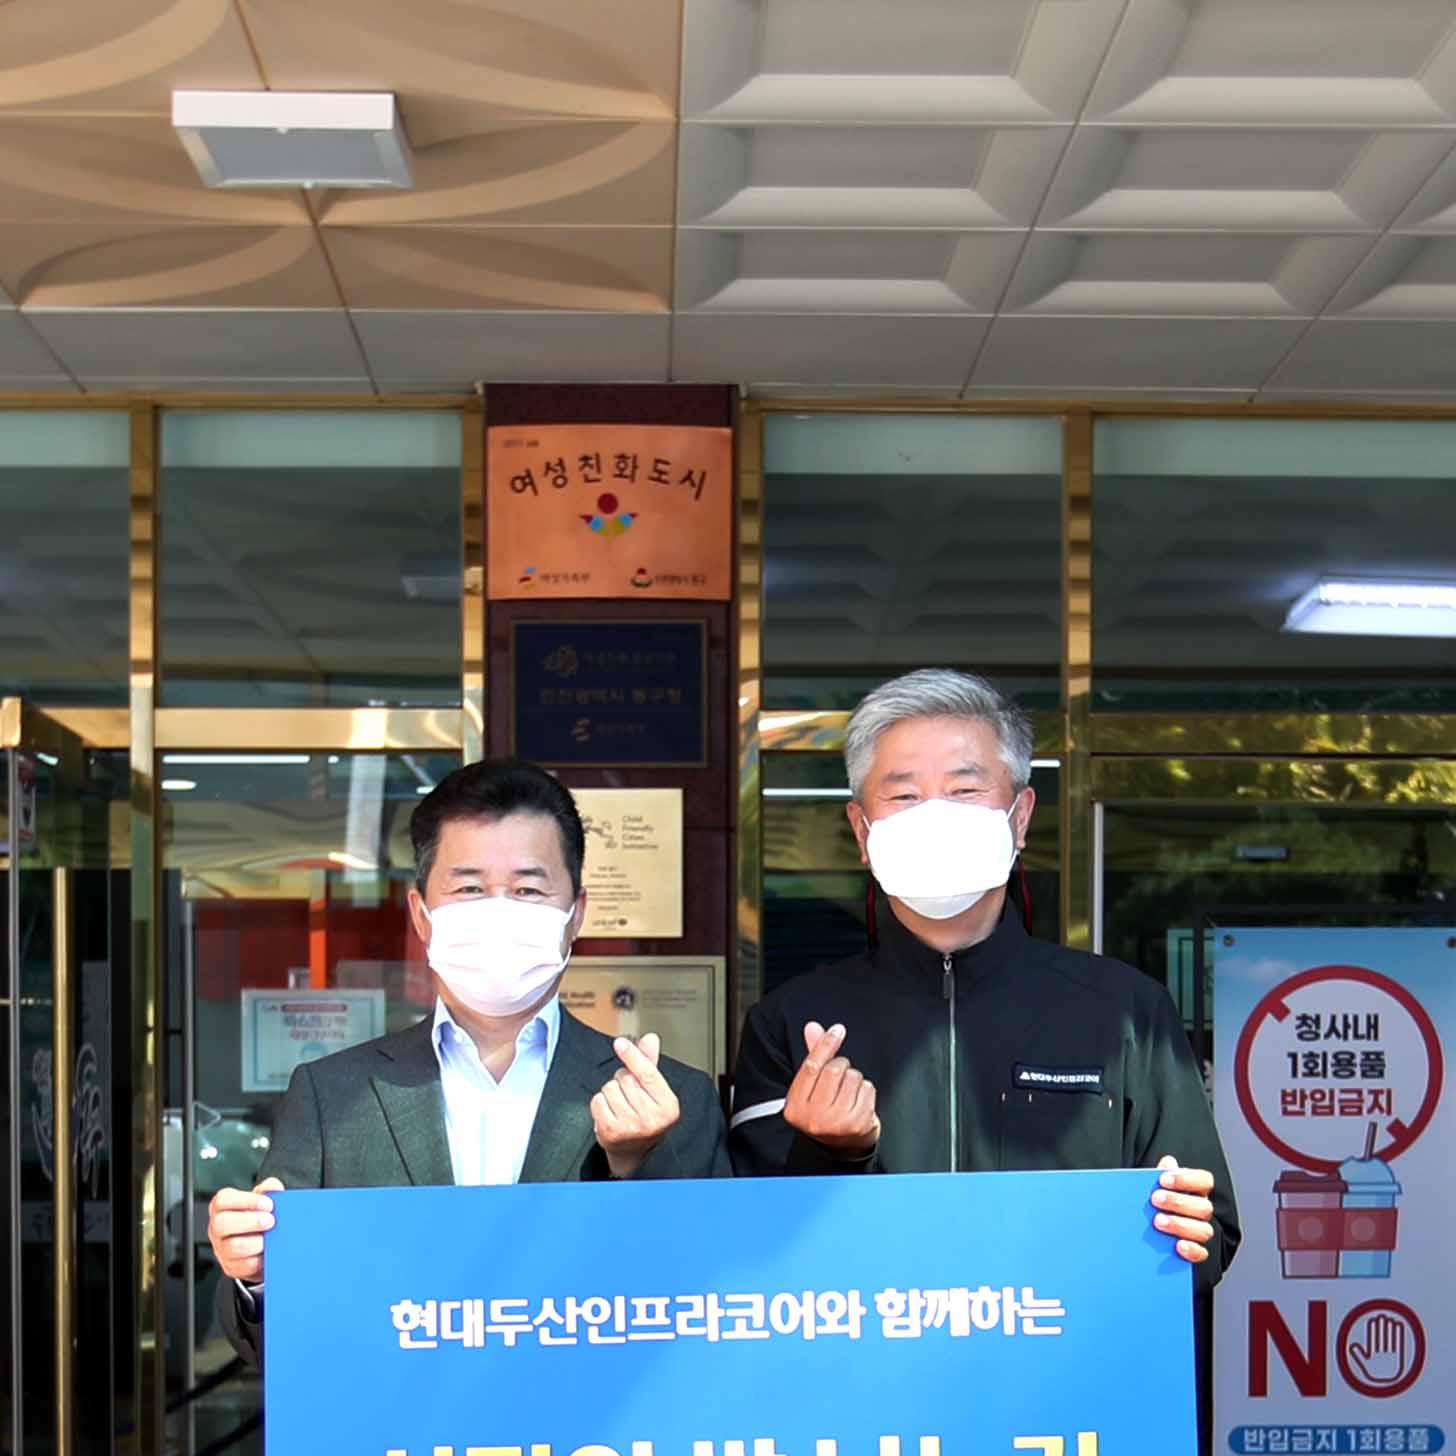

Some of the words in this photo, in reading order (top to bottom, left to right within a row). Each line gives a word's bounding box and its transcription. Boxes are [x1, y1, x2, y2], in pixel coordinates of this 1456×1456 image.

[510, 453, 706, 501] 여성친화도시
[1296, 1014, 1379, 1042] 청사내
[1287, 1051, 1386, 1080] 1회용품
[1280, 1088, 1393, 1117] 반입금지
[389, 1292, 866, 1351] 현대두산인프라코어와
[875, 1286, 1066, 1341] 함께하는
[1248, 1298, 1427, 1399] NO
[1244, 1427, 1337, 1451] 반입금지
[1346, 1428, 1430, 1451] 1회용품
